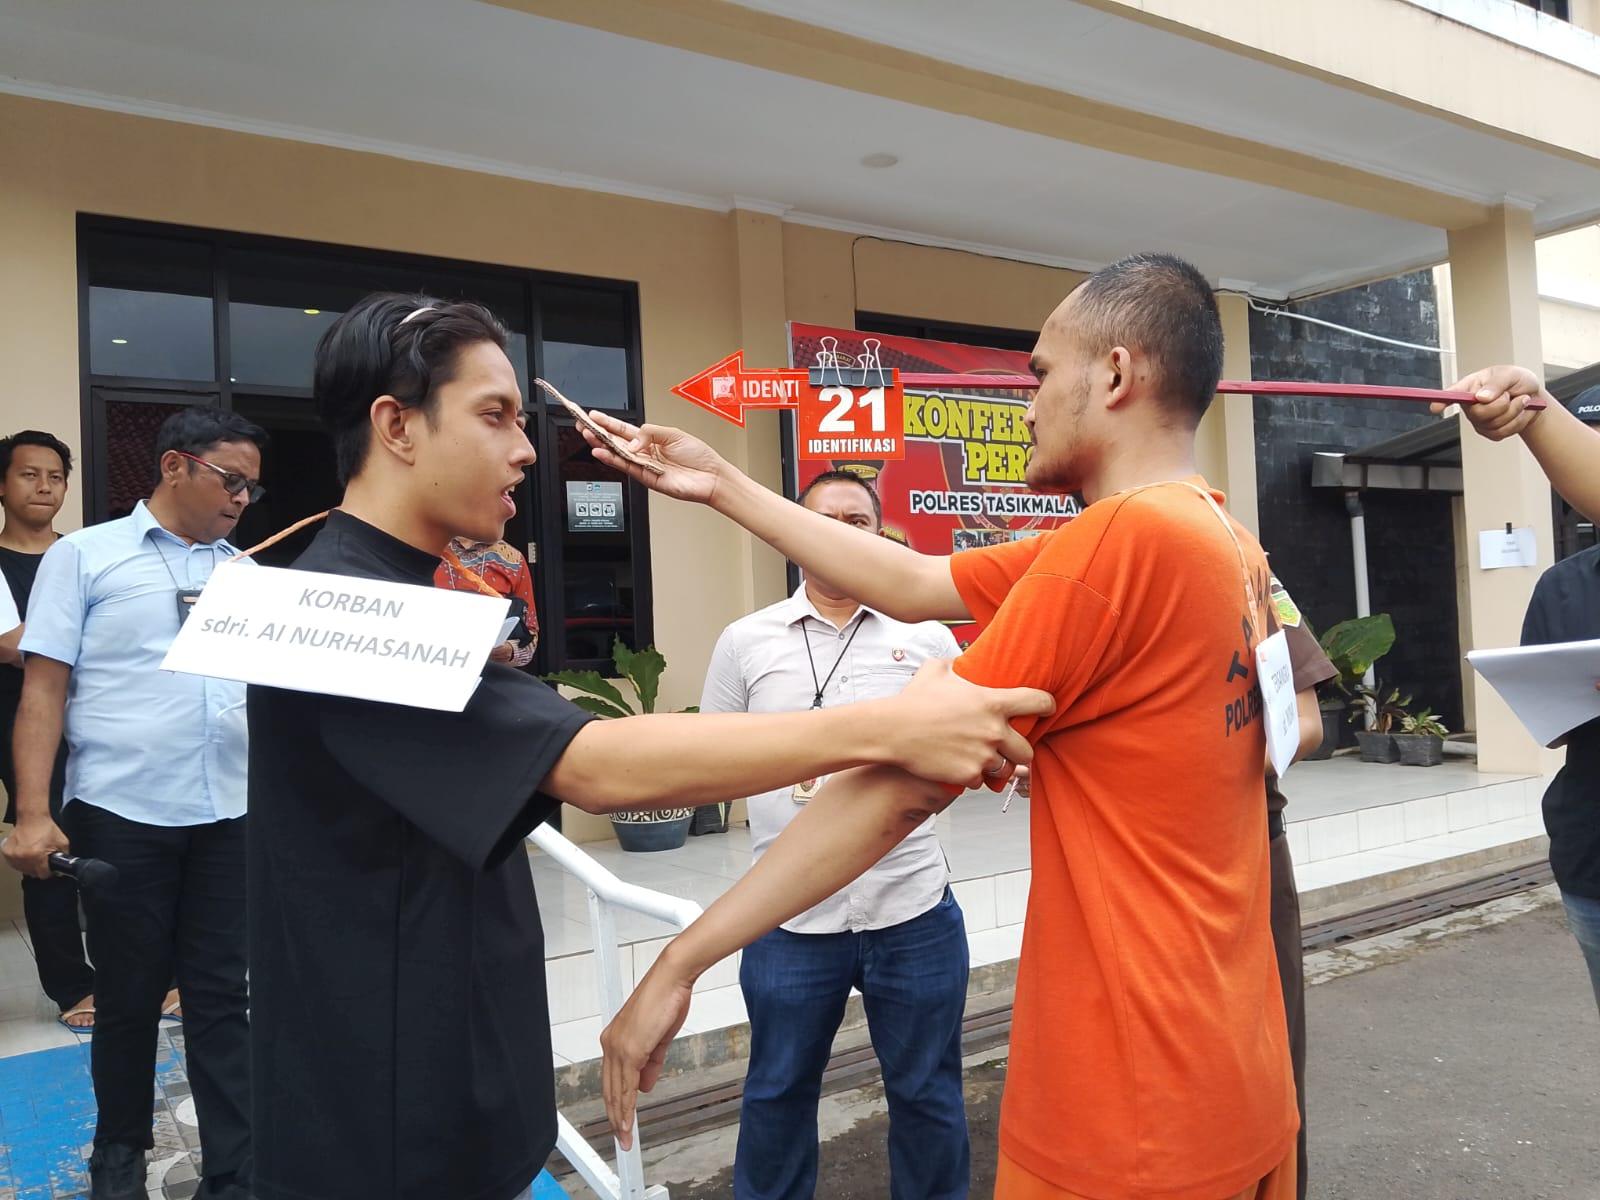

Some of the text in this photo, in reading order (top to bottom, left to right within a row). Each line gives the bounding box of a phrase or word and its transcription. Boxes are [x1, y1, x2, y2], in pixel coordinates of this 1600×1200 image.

[818, 385, 886, 433] 21
[808, 438, 896, 454] IDENTIFIKASI
[965, 442, 1035, 481] PER
[912, 493, 981, 512] POLRES
[298, 587, 405, 619] KORBAN
[201, 615, 471, 670] sdri. AI NURHASANAH
